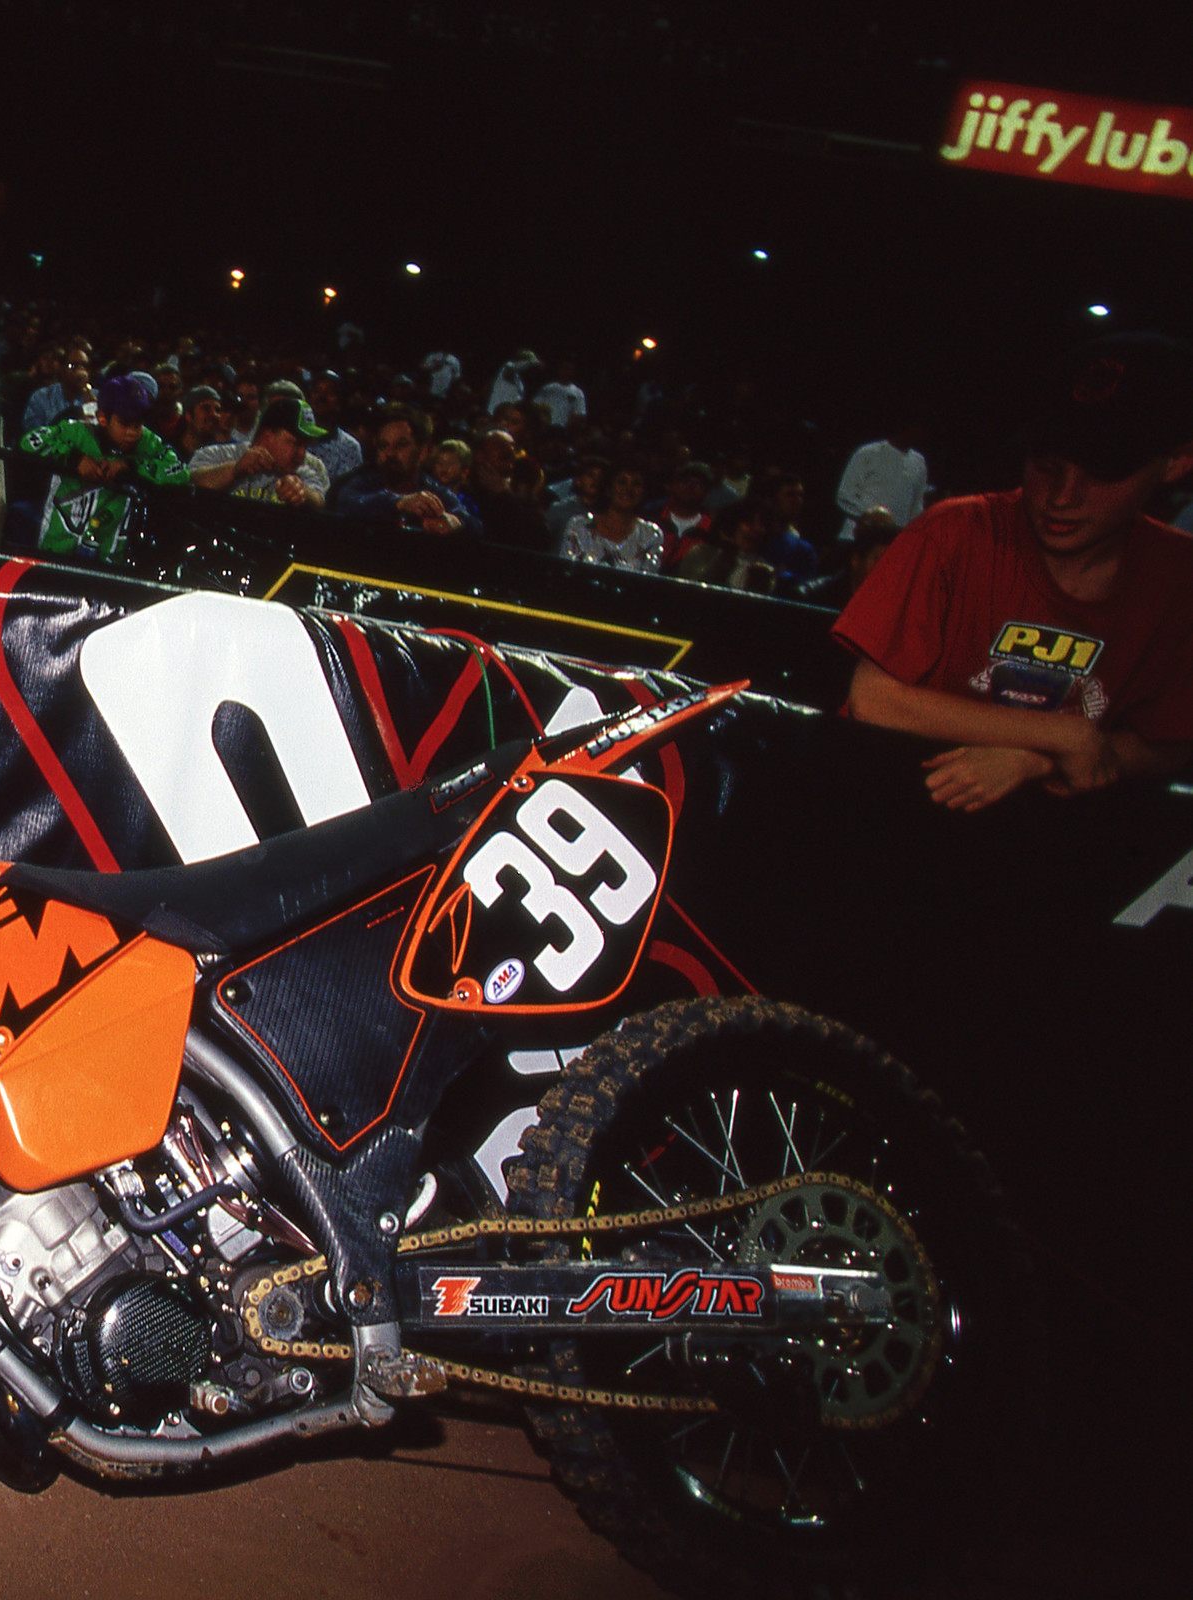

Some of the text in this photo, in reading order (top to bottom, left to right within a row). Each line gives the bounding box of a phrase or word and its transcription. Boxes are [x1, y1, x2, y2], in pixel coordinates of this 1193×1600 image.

[940, 92, 1193, 176] jiffy lub
[997, 625, 1097, 669] PJ1
[462, 778, 658, 992] 39
[492, 963, 517, 994] AMA
[431, 1276, 549, 1317] TSUBAKI
[773, 1273, 814, 1289] brembo
